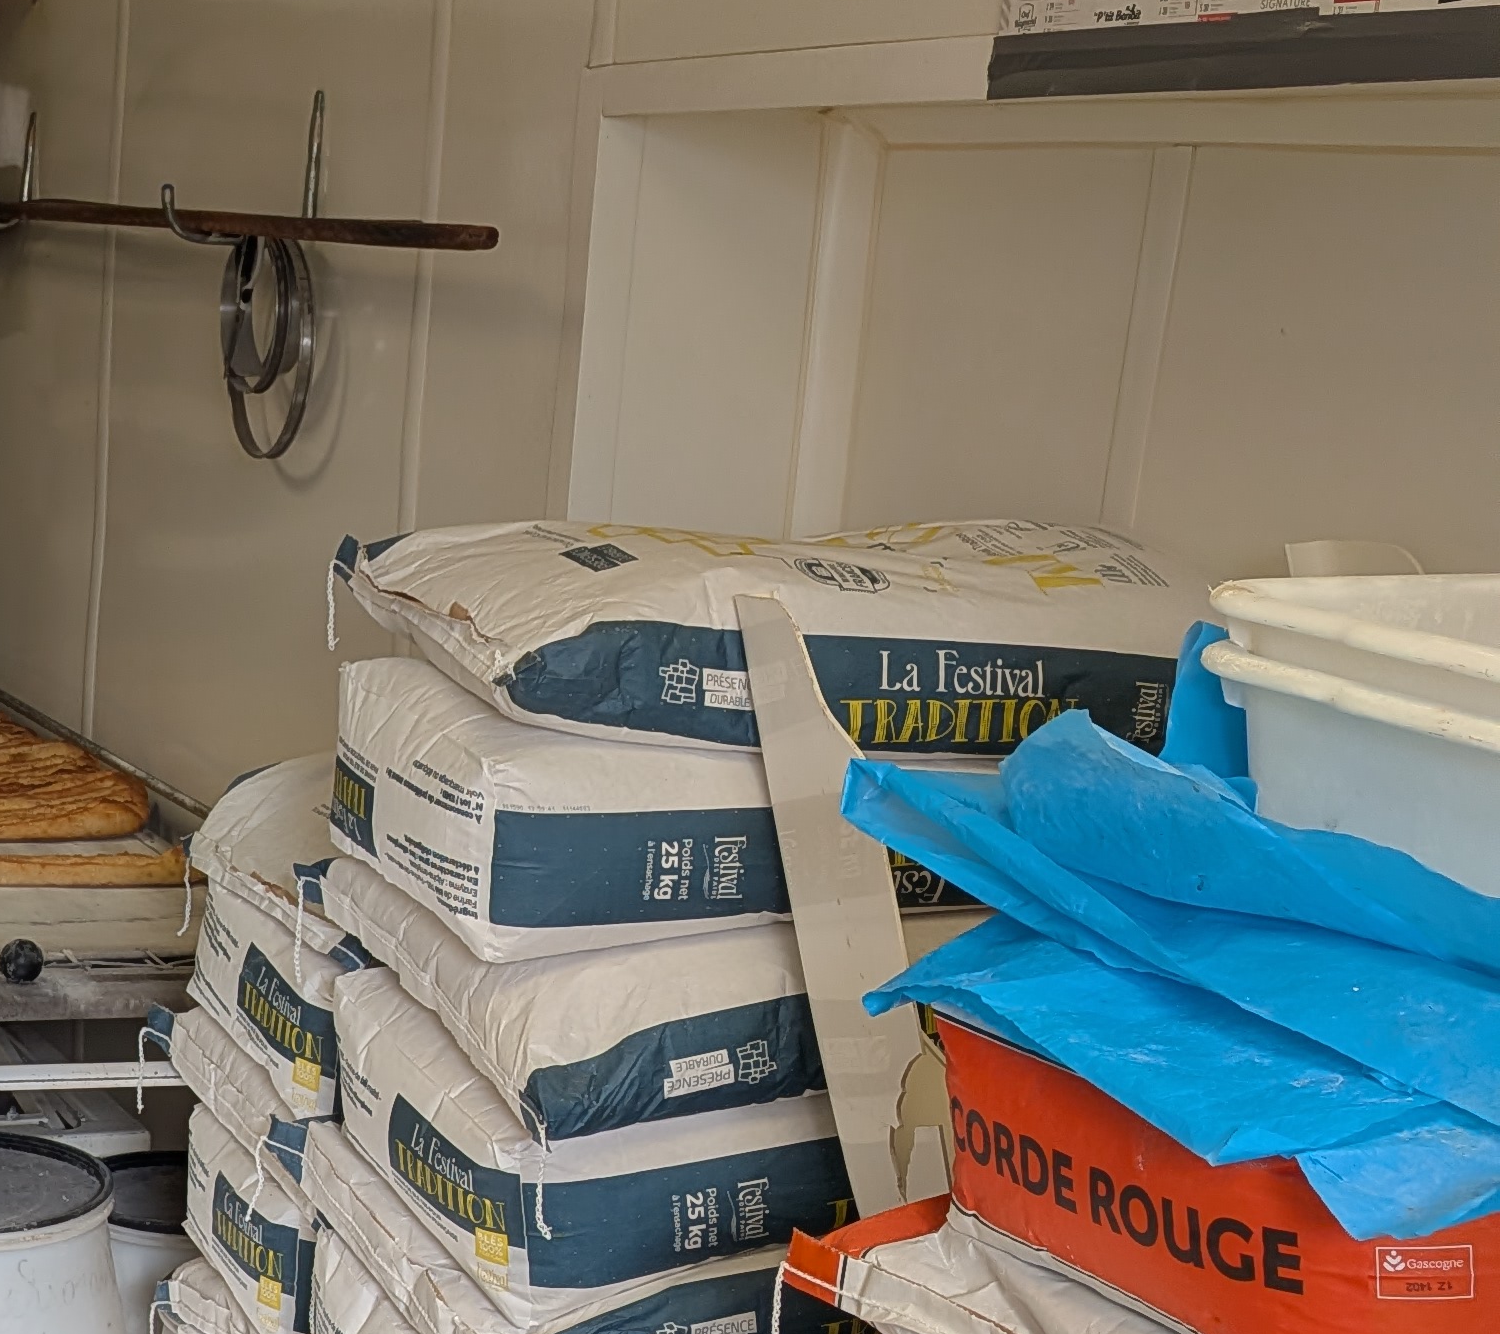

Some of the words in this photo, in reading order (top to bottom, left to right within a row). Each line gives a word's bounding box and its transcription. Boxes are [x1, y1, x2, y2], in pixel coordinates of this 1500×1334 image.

[705, 674, 751, 690] PRÉSEN
[879, 650, 921, 692] La
[936, 649, 1045, 698] Festival
[839, 698, 1079, 743] TRADITIO
[1127, 680, 1161, 744] Festival
[661, 841, 679, 869] 25
[682, 839, 693, 877] Poids
[714, 836, 747, 899] Festival
[654, 875, 679, 900] kg
[678, 879, 688, 901] net
[256, 966, 268, 992] La
[270, 977, 301, 1025] Festival
[244, 980, 324, 1063] TRADITION
[676, 1053, 724, 1072] DURABLE
[667, 1069, 731, 1094] PRÉSENCE
[411, 1123, 424, 1158] La
[427, 1136, 474, 1193] Festival
[395, 1139, 505, 1232] TRADITION
[705, 1187, 717, 1218] Poids
[952, 1094, 1079, 1212] CORDE
[1089, 1166, 1306, 1295] ROUGE
[685, 1192, 705, 1220] 25
[737, 1177, 769, 1240] Festival
[685, 1224, 707, 1249] kg
[708, 1224, 718, 1247] net
[1407, 1258, 1464, 1271] Gascogne
